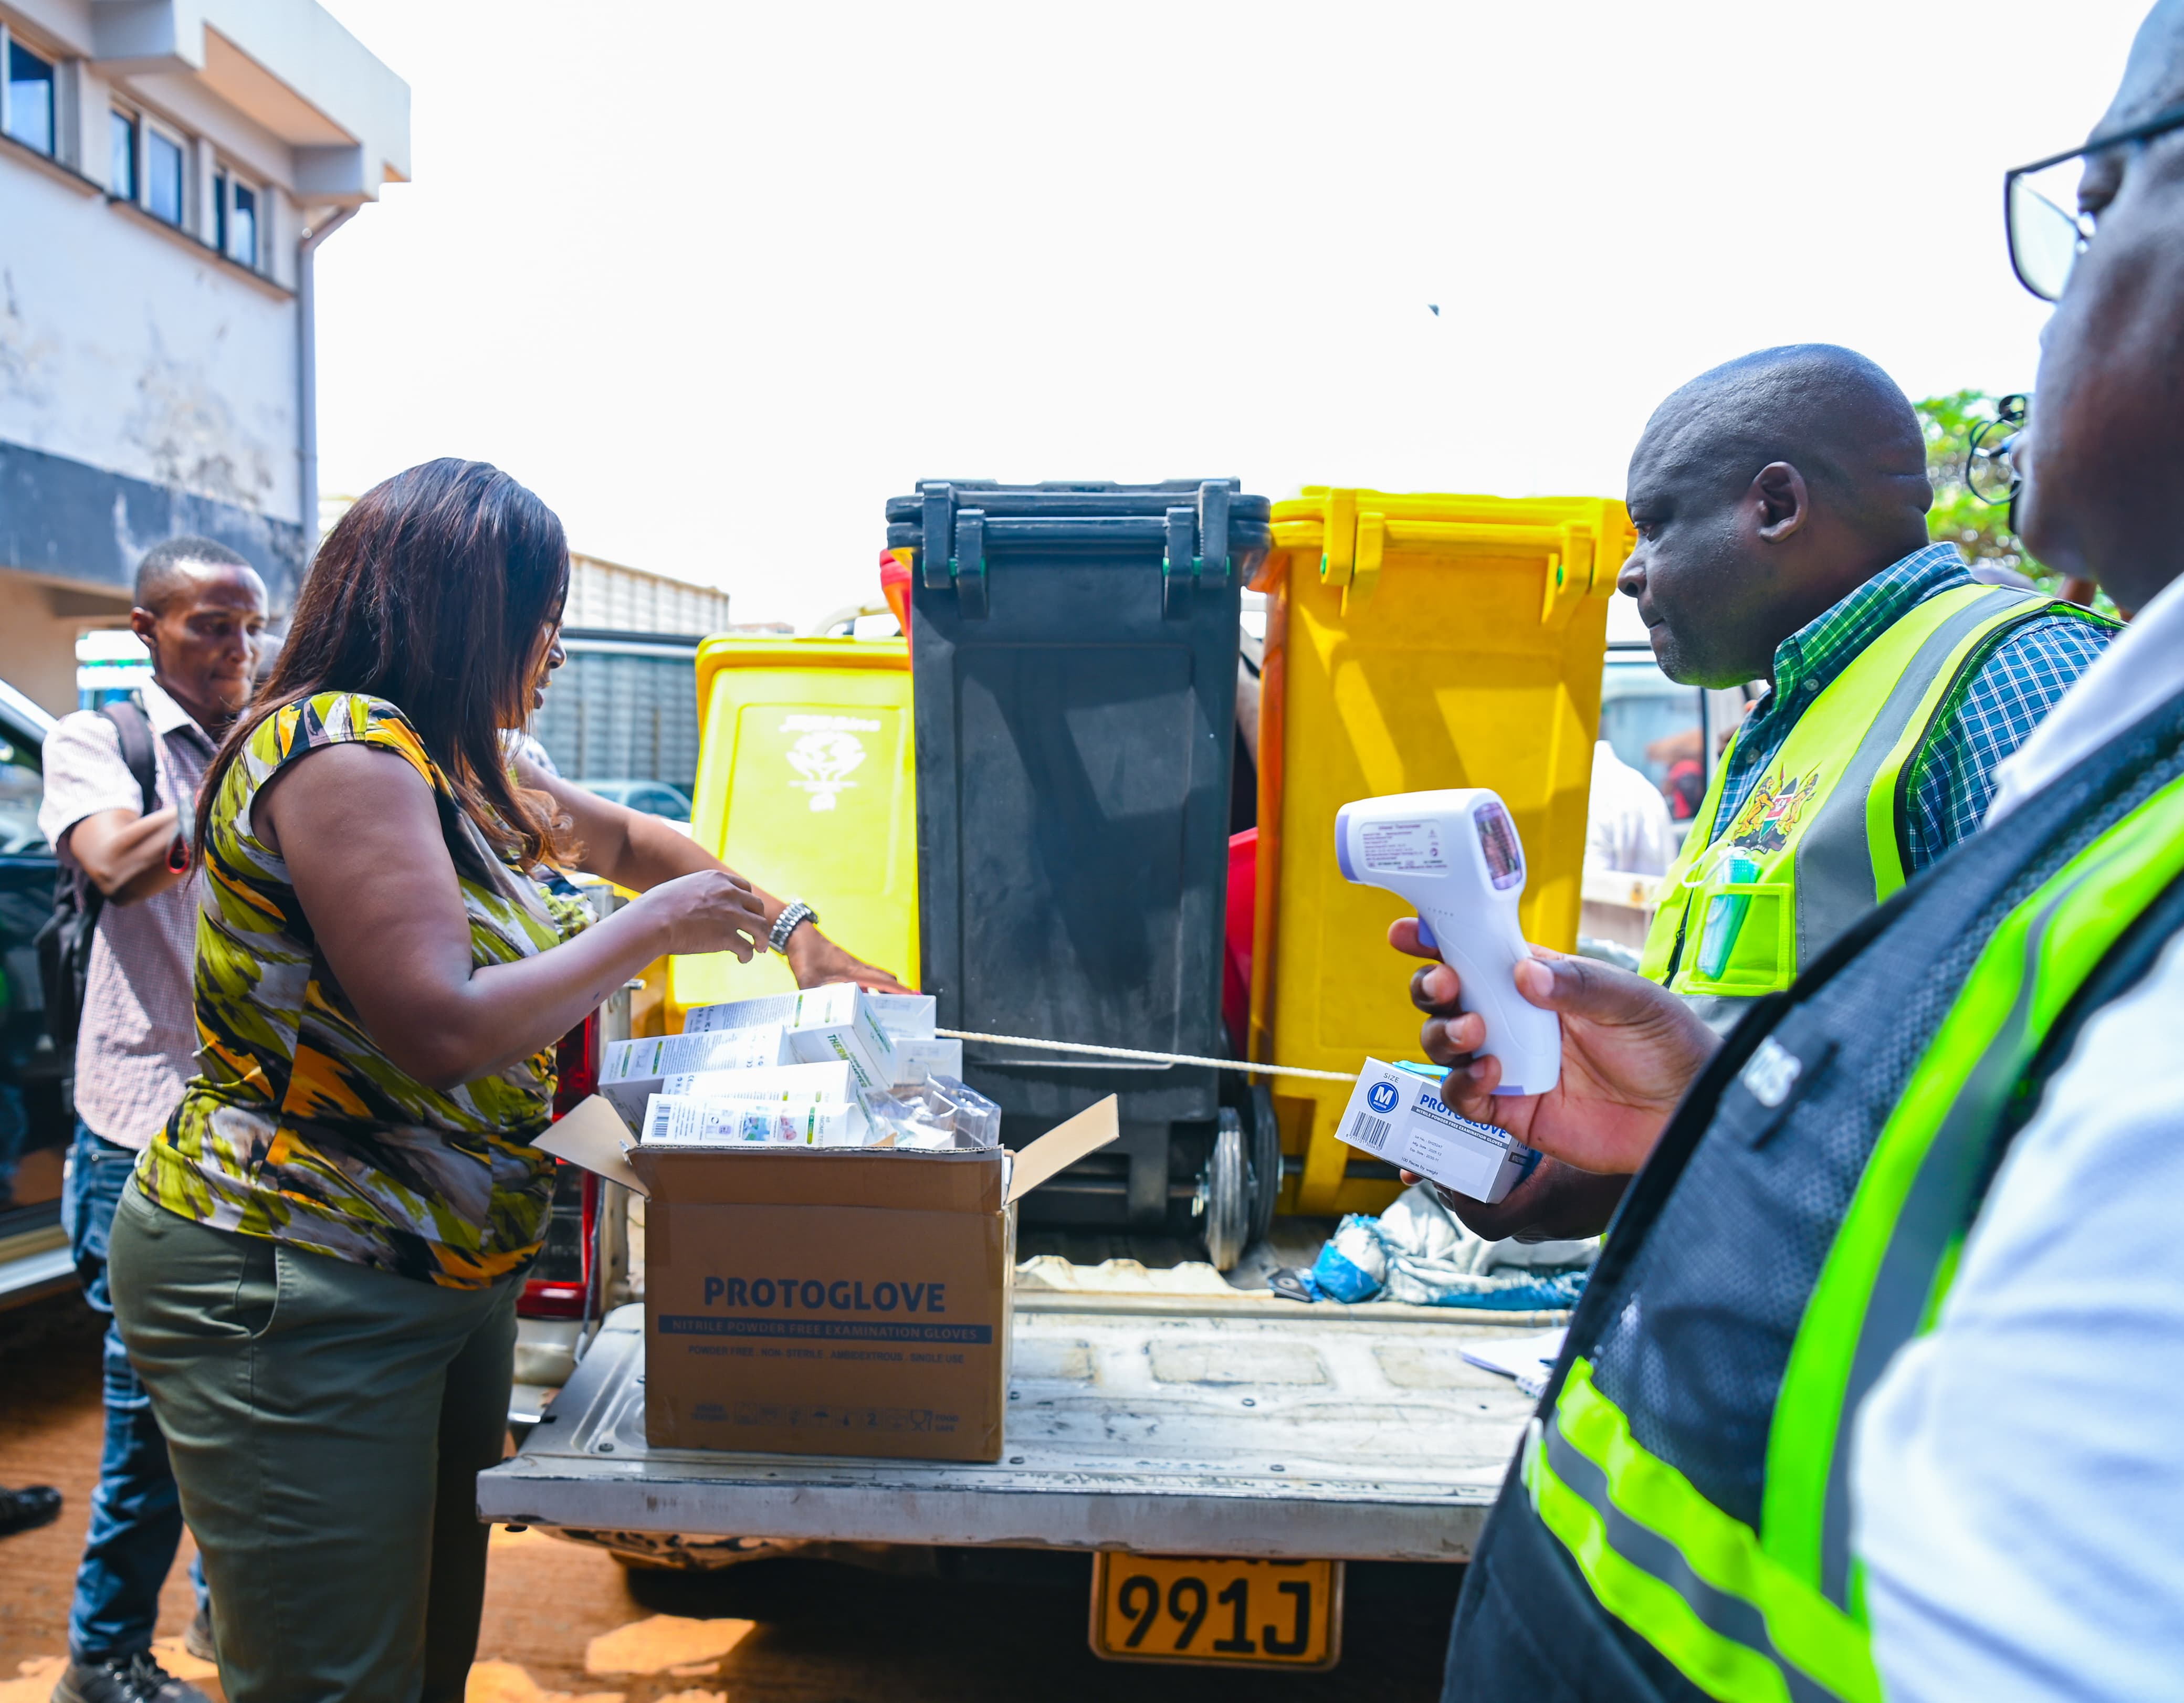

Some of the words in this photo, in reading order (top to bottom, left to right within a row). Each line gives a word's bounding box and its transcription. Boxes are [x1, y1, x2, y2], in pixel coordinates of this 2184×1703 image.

[1383, 1073, 1400, 1083] SIZE
[1374, 1086, 1394, 1105] M
[1416, 1108, 1431, 1118] NITRILE
[1431, 1114, 1448, 1124] POWDER
[1458, 1124, 1487, 1140] EXAMINATION
[1486, 1136, 1503, 1147] GLOVES
[704, 1276, 946, 1312] PROTOGLOVE
[672, 1319, 723, 1332] NITRILE
[727, 1321, 785, 1334] POWDER
[789, 1323, 821, 1336] FREE
[825, 1325, 920, 1339] EXAMINATION
[924, 1327, 977, 1340] GLOVES
[688, 1345, 728, 1356] POWDER
[730, 1347, 754, 1357] FREE
[785, 1348, 823, 1359] STERILE
[830, 1350, 904, 1362] AMBIDEXTROUS
[910, 1352, 942, 1363] SINGLE
[945, 1353, 964, 1364] USE
[1118, 1575, 1311, 1656] 991J
